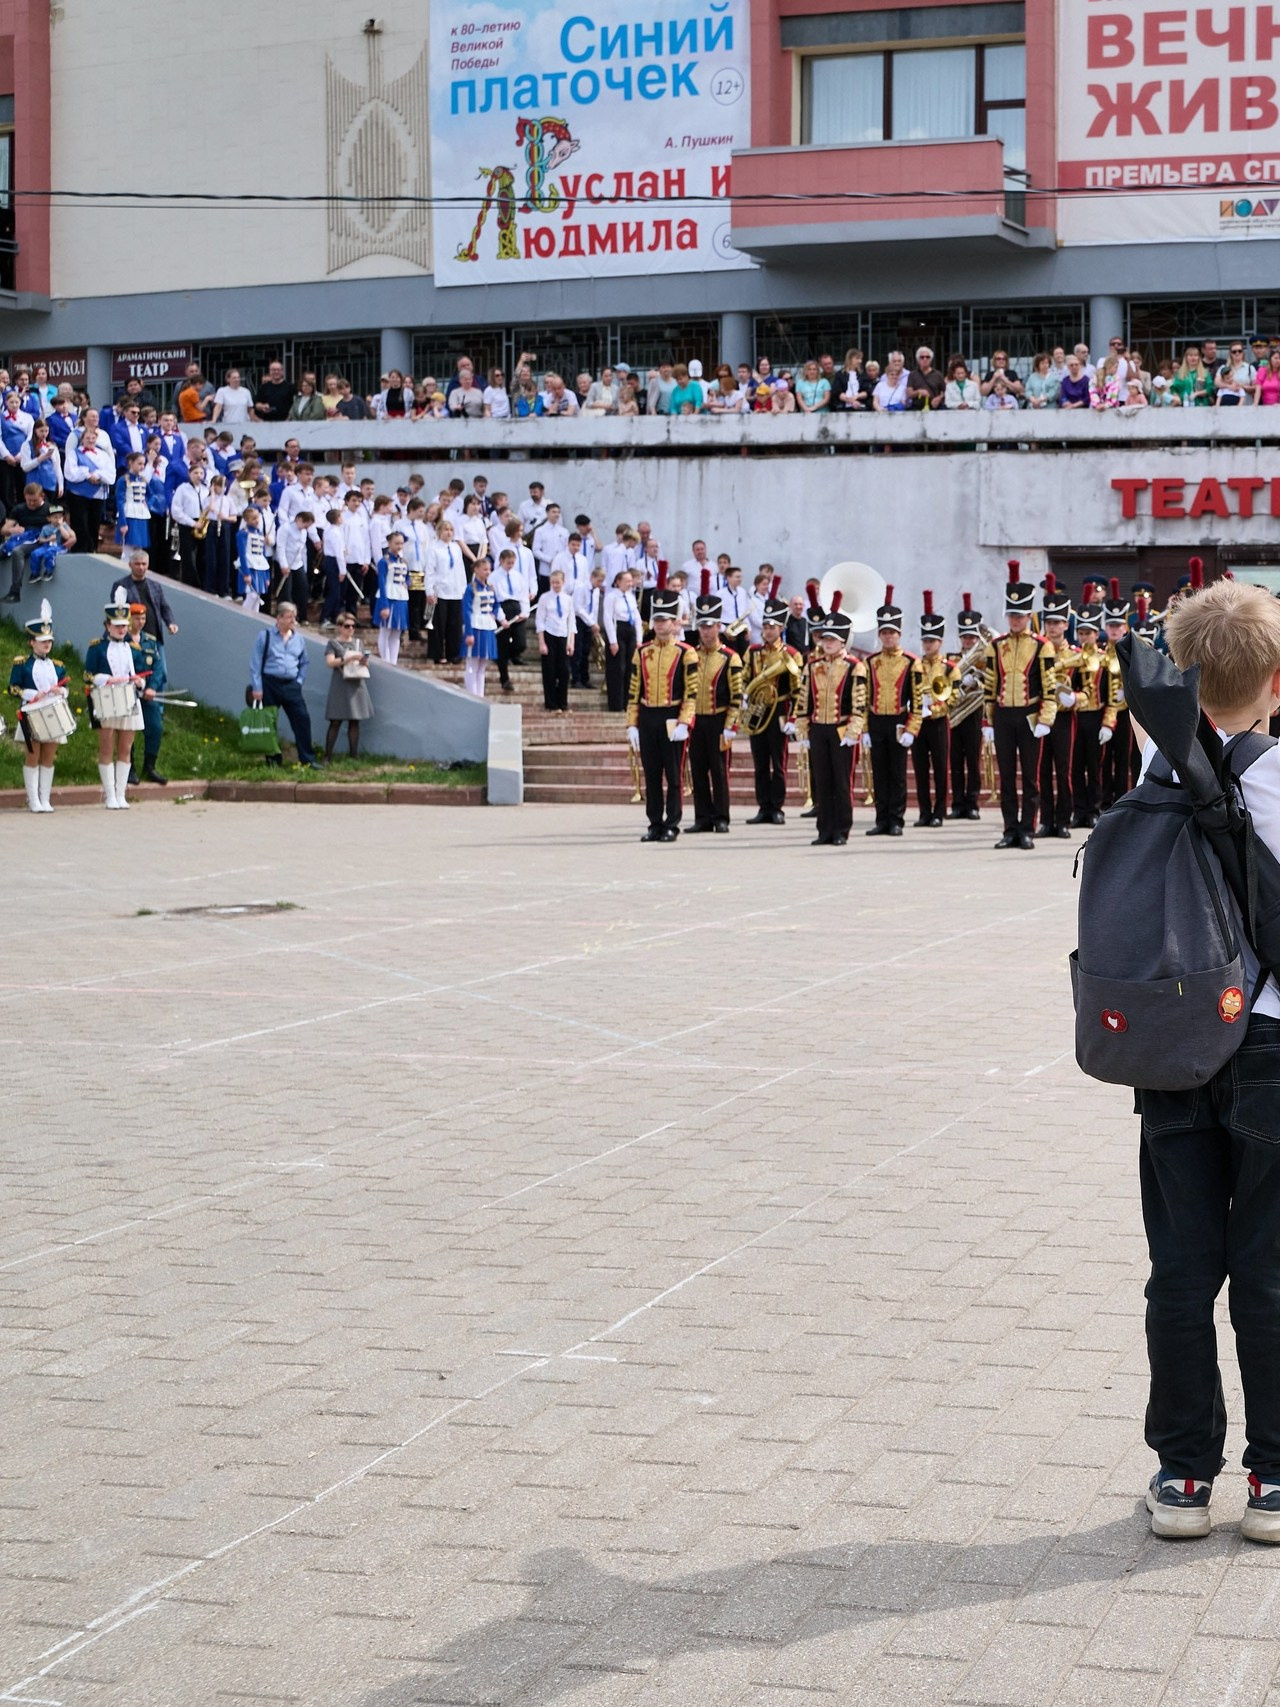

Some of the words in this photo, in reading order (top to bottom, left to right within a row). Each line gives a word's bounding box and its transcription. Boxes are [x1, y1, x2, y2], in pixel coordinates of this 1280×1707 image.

[451, 28, 457, 36] к
[560, 2, 733, 63] Синий
[451, 38, 503, 53] Великой
[451, 56, 500, 71] Победы
[451, 61, 700, 115] платочек
[716, 80, 741, 96] 12+
[664, 137, 679, 149] А.
[682, 135, 733, 149] Пушкин
[1086, 162, 1236, 187] ПРЕМЬЕРА
[117, 348, 186, 362] ДРАМАТИЧЕСКИЙ
[49, 360, 85, 377] КУКОЛ
[129, 362, 169, 377] ТЕАТР
